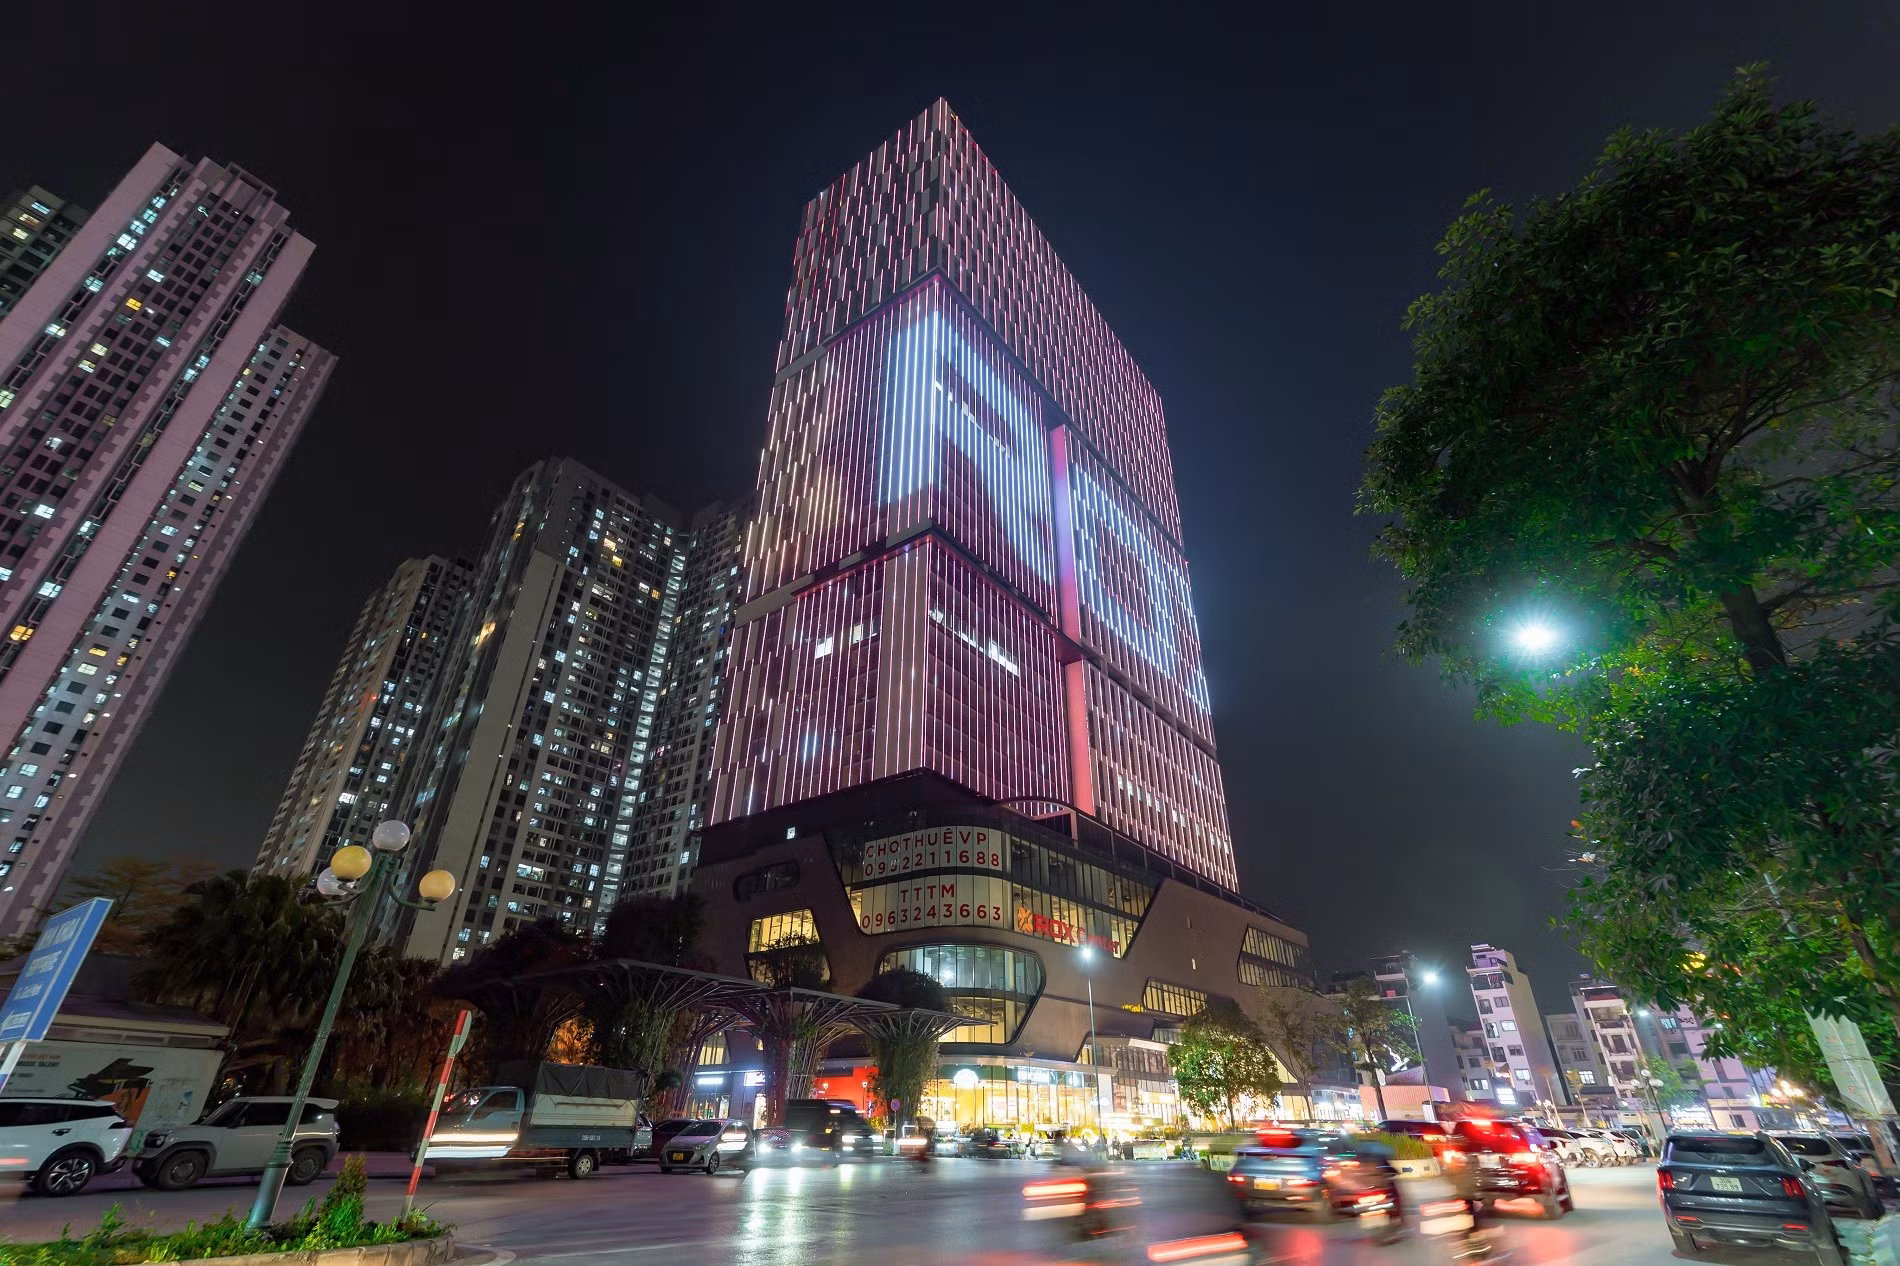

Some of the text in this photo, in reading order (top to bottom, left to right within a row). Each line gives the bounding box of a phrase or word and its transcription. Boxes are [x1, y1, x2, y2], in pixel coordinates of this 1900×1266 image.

[900, 883, 955, 903] TTTM
[861, 903, 1001, 929] 0963243663
[1033, 913, 1076, 944] ROX
